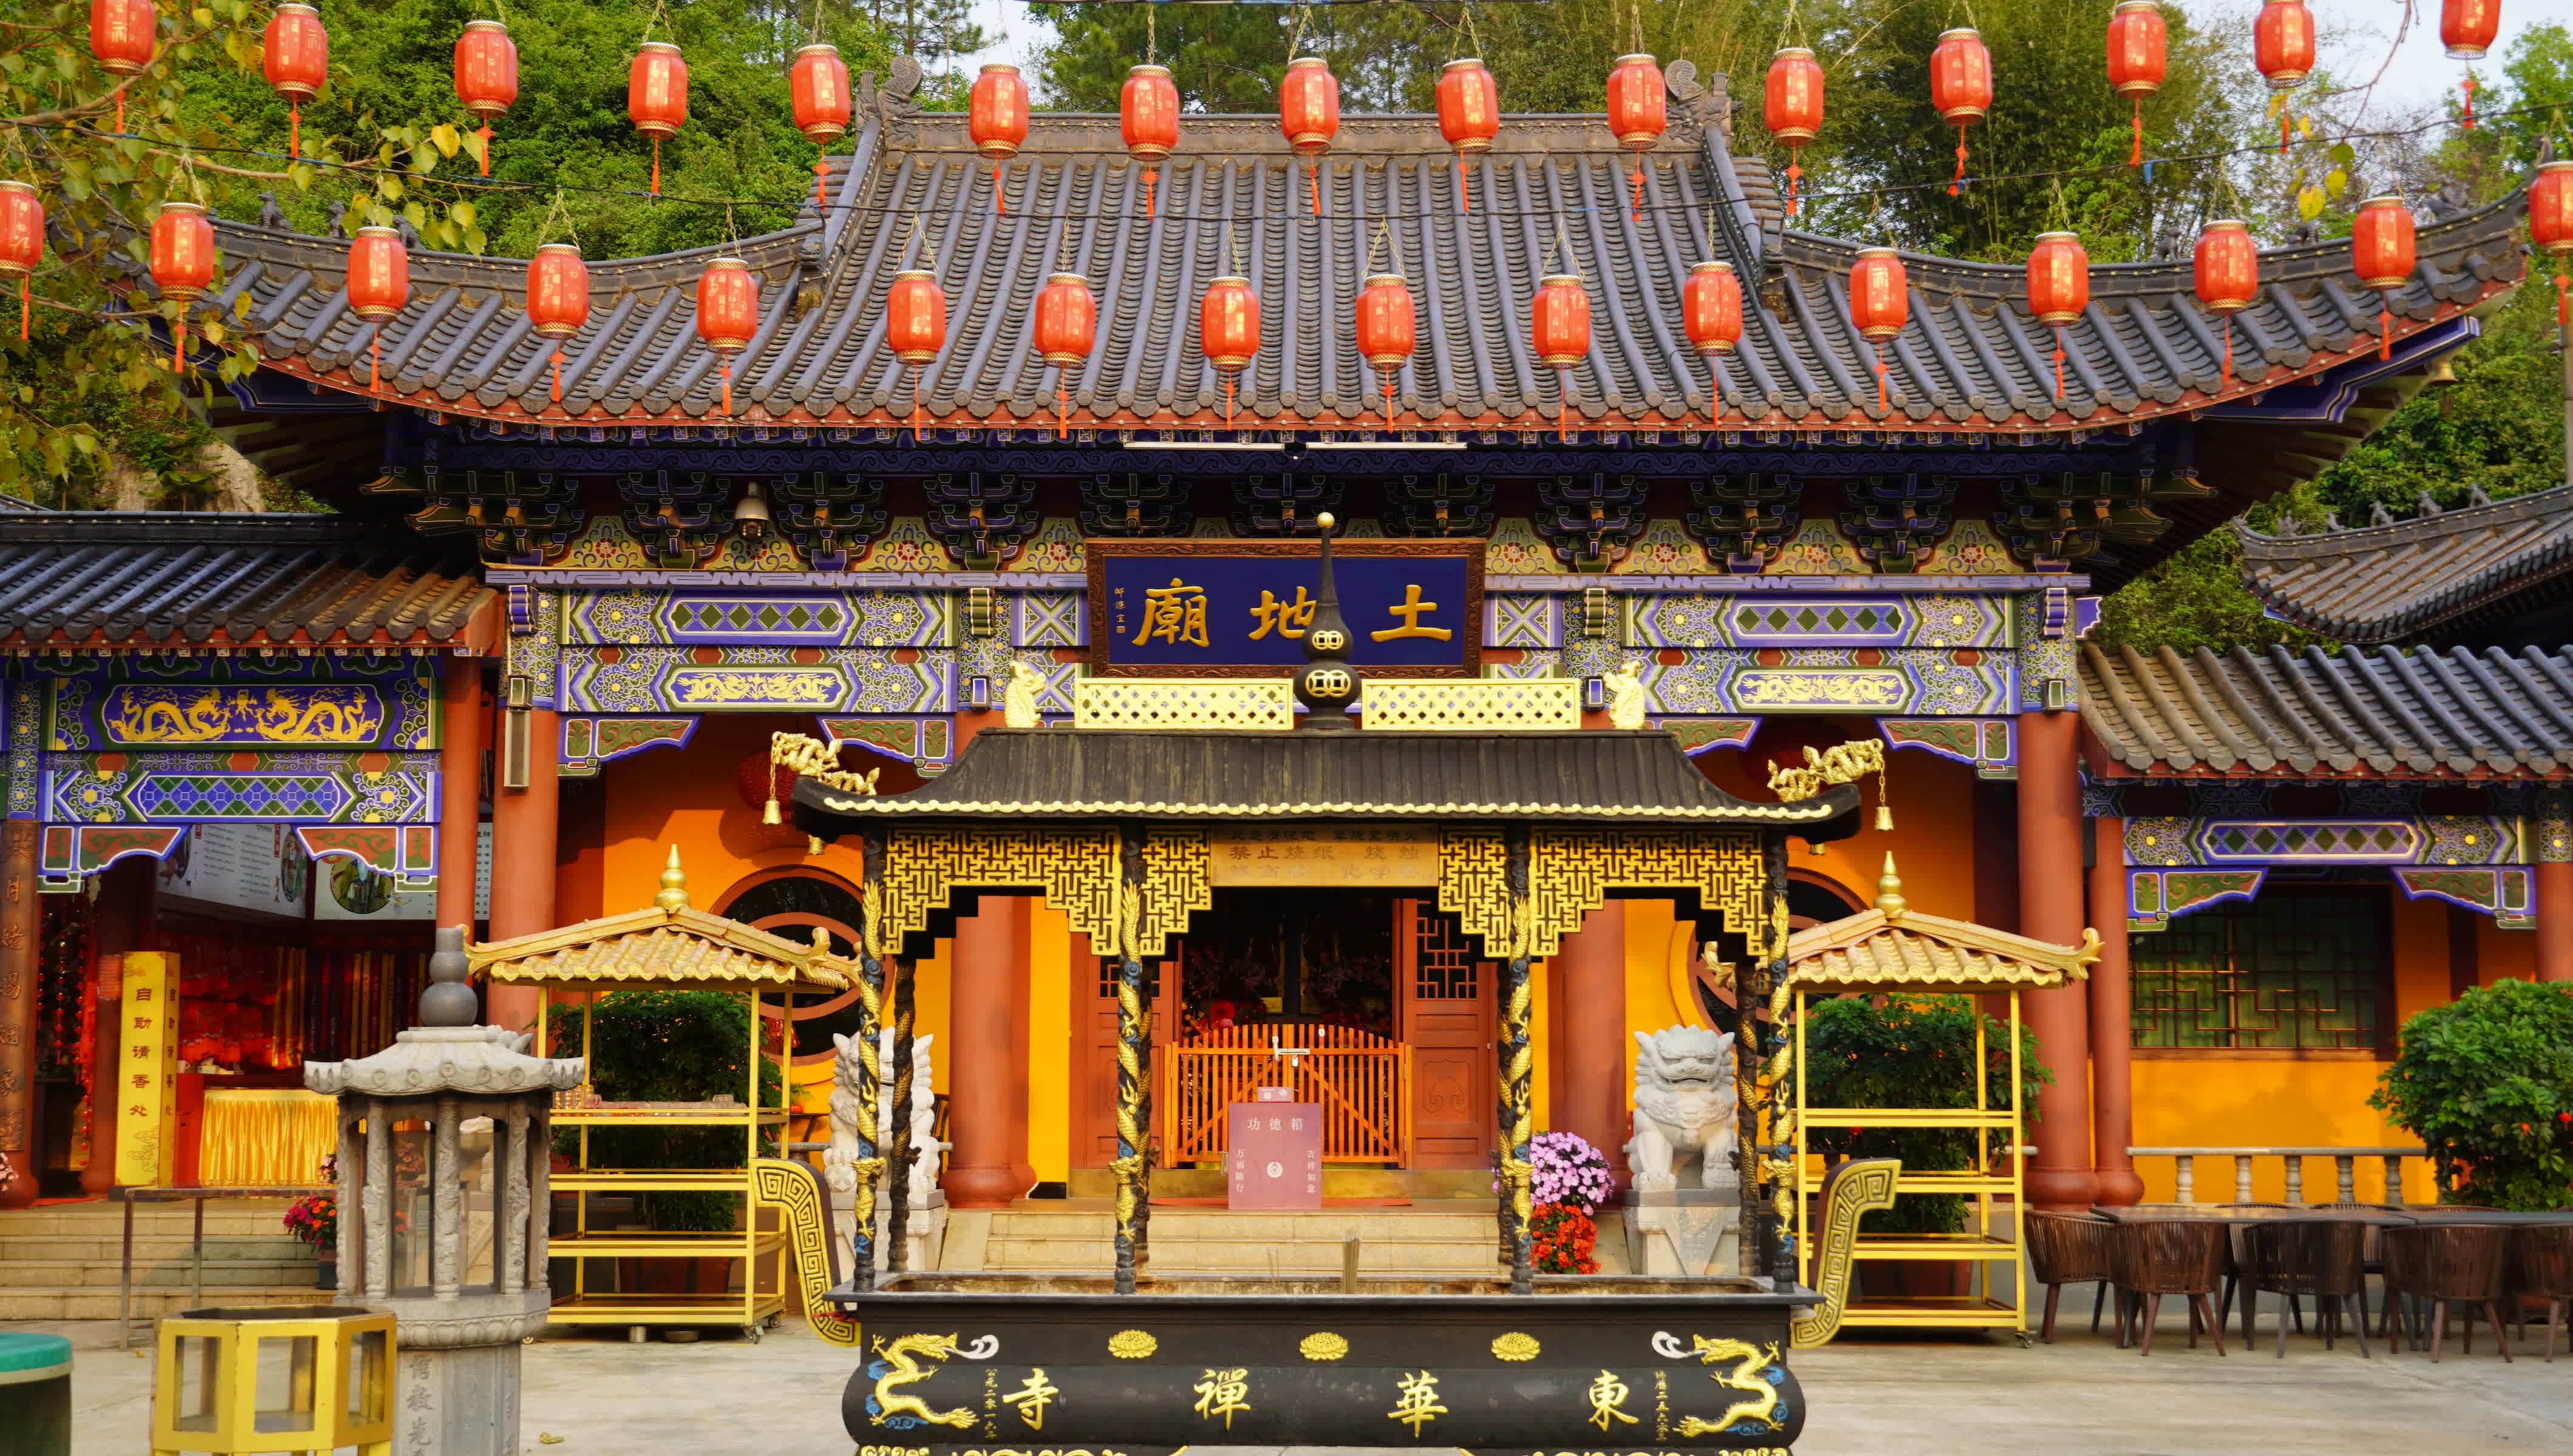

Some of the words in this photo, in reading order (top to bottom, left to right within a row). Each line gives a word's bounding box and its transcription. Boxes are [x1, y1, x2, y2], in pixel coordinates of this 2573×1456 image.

[1132, 577, 1453, 650] 土地廟
[129, 988, 152, 1117] 自助请香处
[1247, 1118, 1303, 1131] 功德箱
[1001, 1367, 1640, 1438] 東華禪寺
